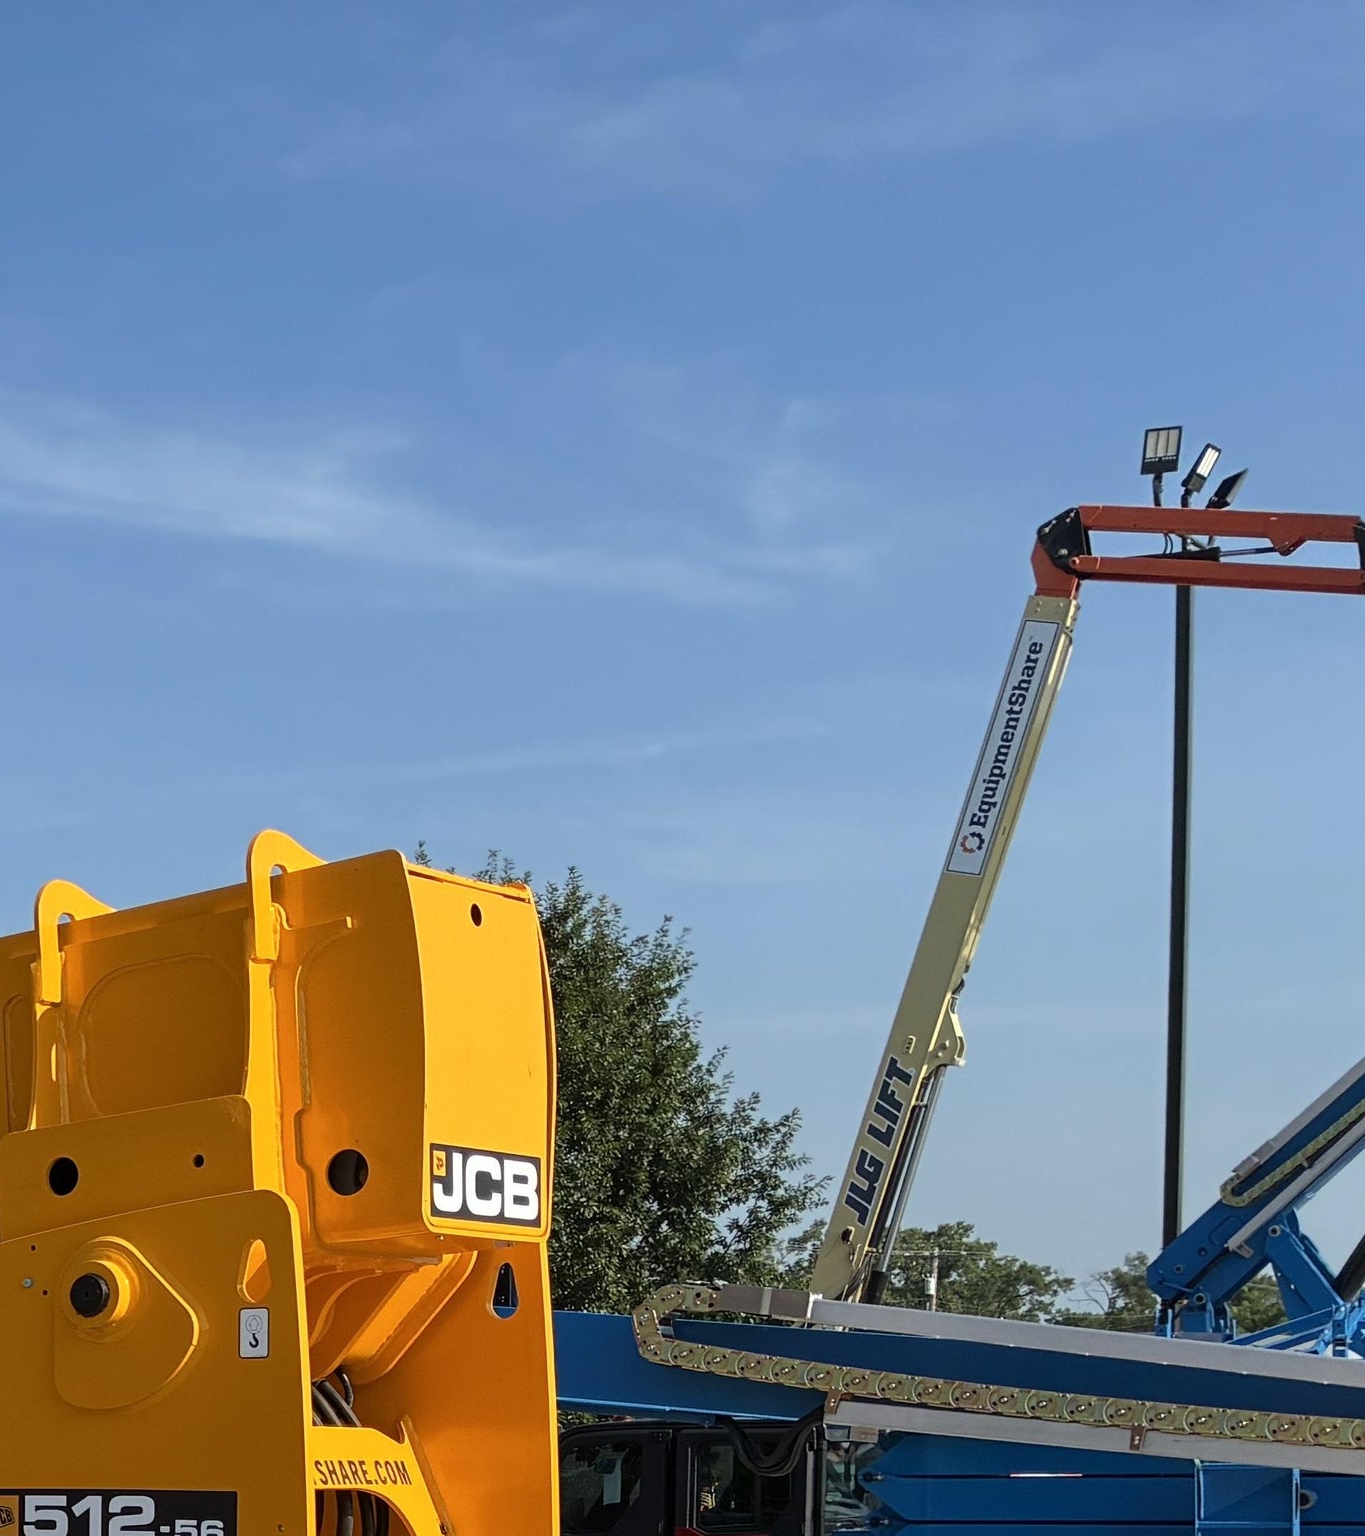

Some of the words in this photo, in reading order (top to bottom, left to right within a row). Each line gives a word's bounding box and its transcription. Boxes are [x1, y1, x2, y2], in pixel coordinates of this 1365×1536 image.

[969, 641, 1043, 828] EquipmentShare
[432, 1151, 539, 1221] JCB
[844, 1148, 885, 1227] JLG
[866, 1055, 913, 1149] LIFT
[313, 1459, 413, 1486] SHARE.COM
